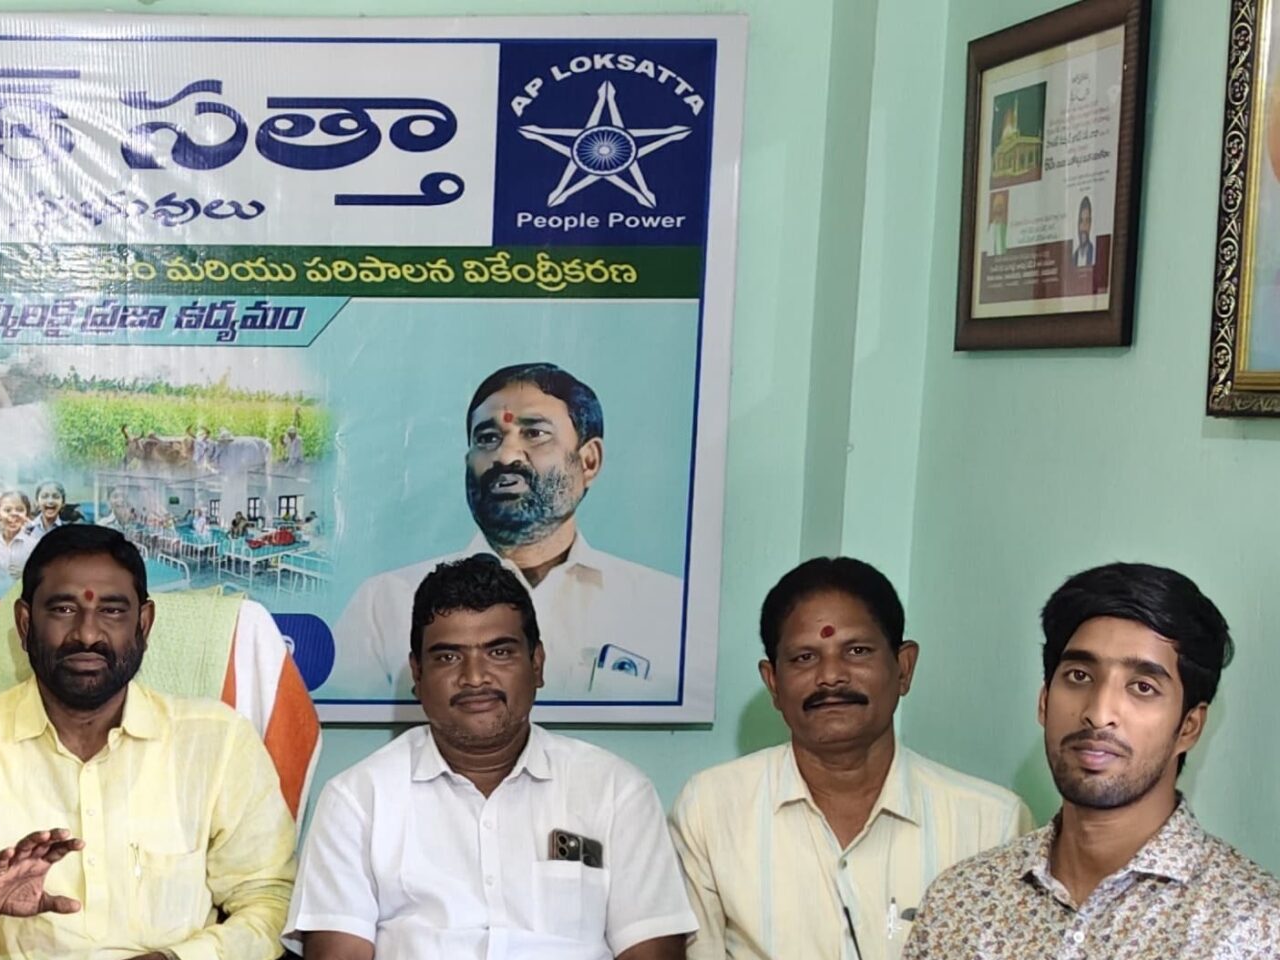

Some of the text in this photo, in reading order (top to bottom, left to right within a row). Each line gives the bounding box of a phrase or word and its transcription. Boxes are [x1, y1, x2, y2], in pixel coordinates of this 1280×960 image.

[511, 54, 705, 117] AP LOKSATTA
[120, 79, 465, 206] సత్తా
[517, 212, 686, 231] People Power
[166, 257, 297, 283] మరియు
[305, 254, 455, 284] పరిపాలన
[81, 299, 167, 333] ప్రజా
[174, 300, 307, 342] ఉద్యమం
